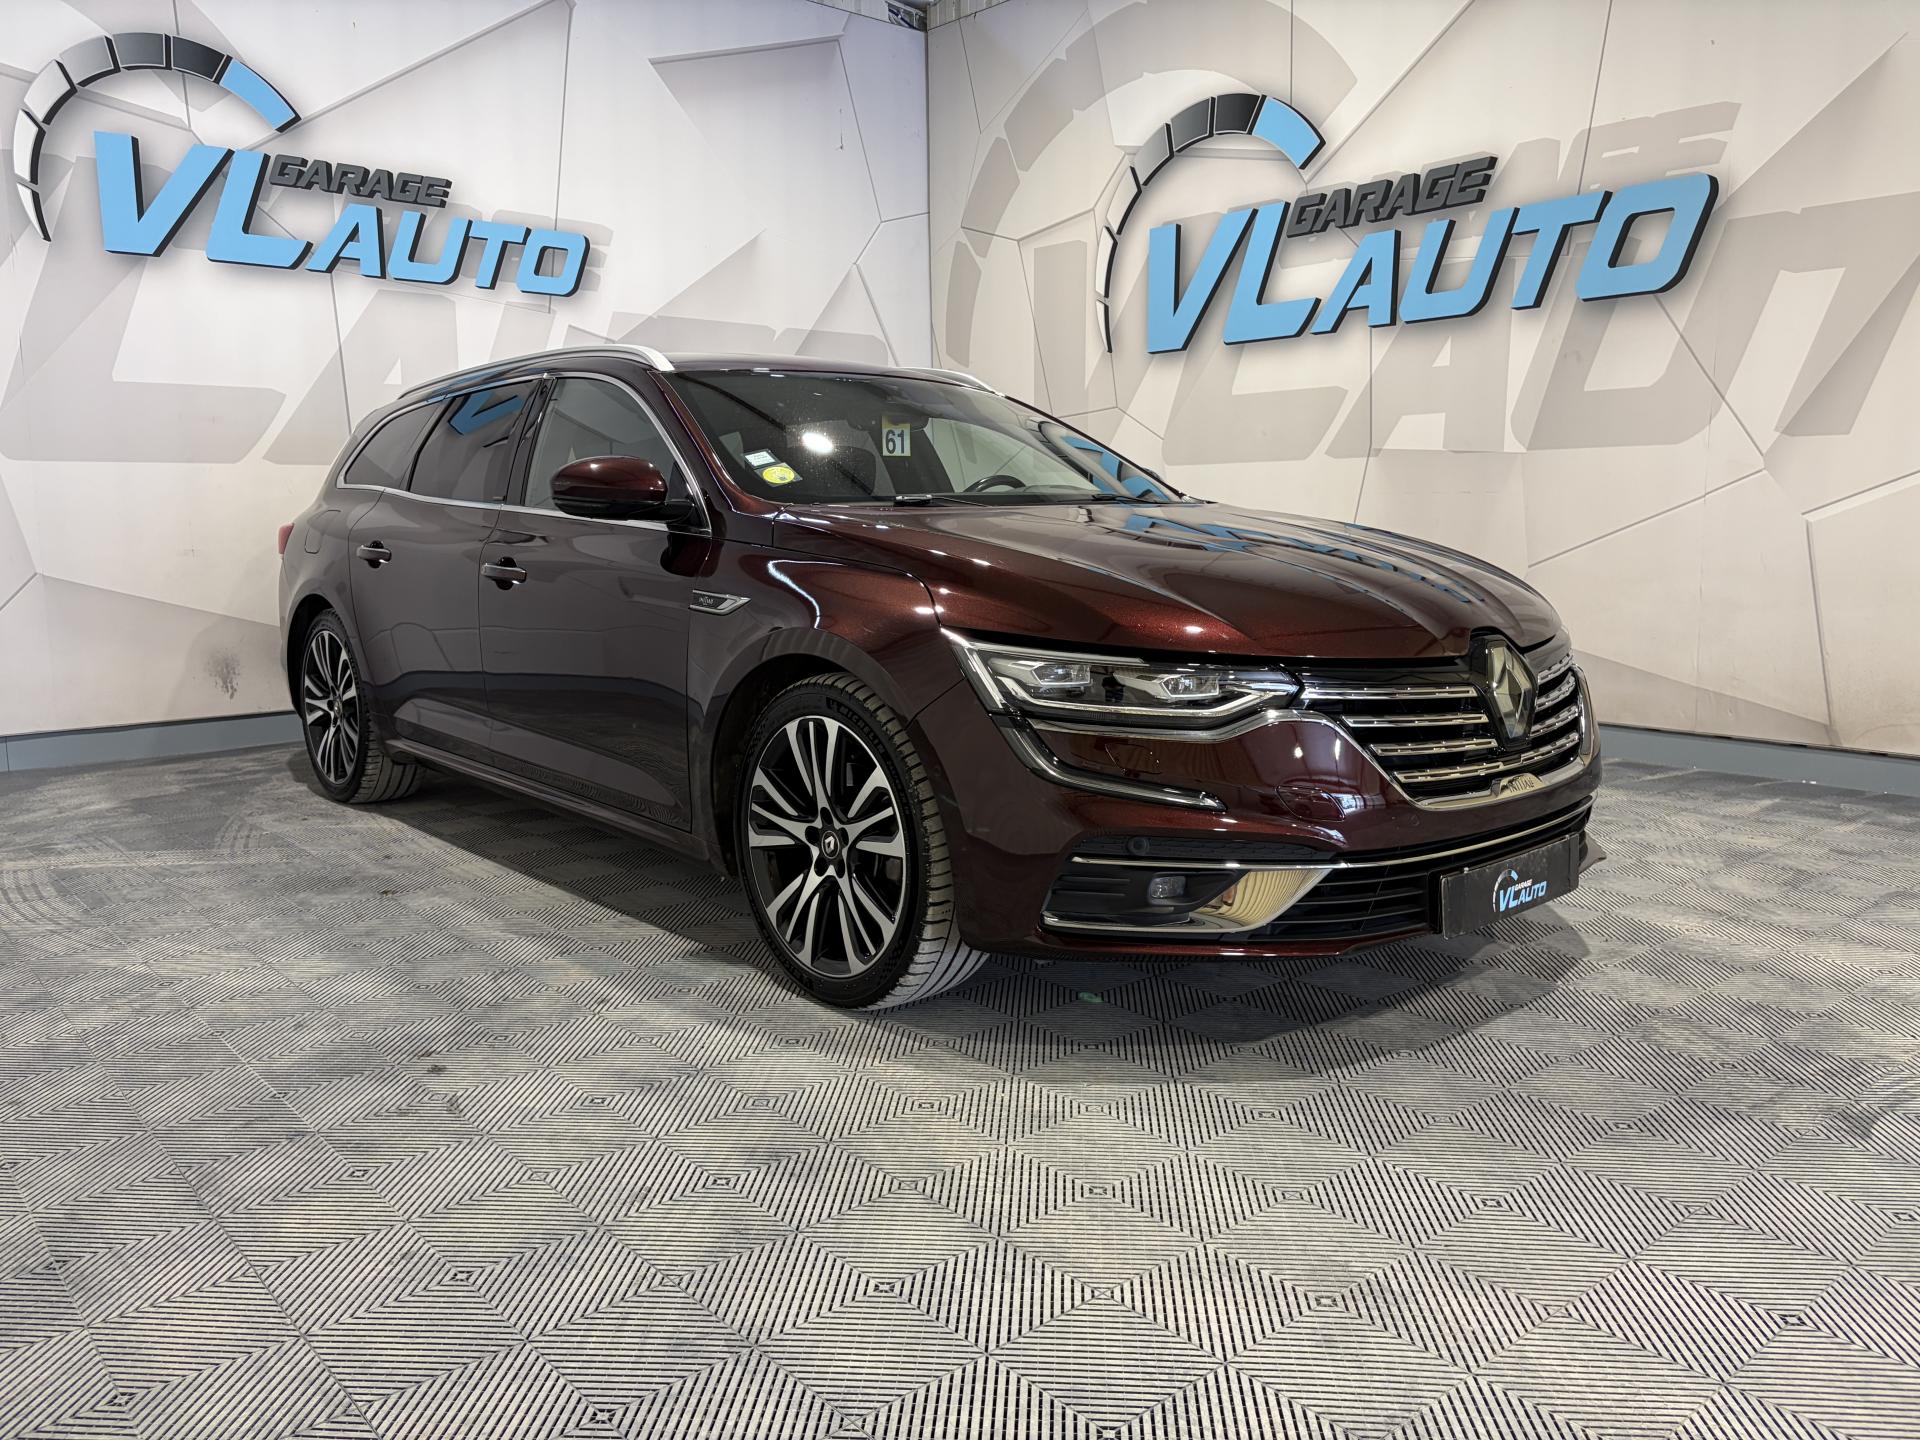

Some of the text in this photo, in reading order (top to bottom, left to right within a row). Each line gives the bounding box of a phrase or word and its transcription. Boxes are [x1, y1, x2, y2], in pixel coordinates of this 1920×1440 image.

[268, 154, 452, 208] GARAGE
[1287, 155, 1499, 238] GARAGE
[885, 428, 906, 455] 61
[1514, 878, 1533, 891] GARAGE
